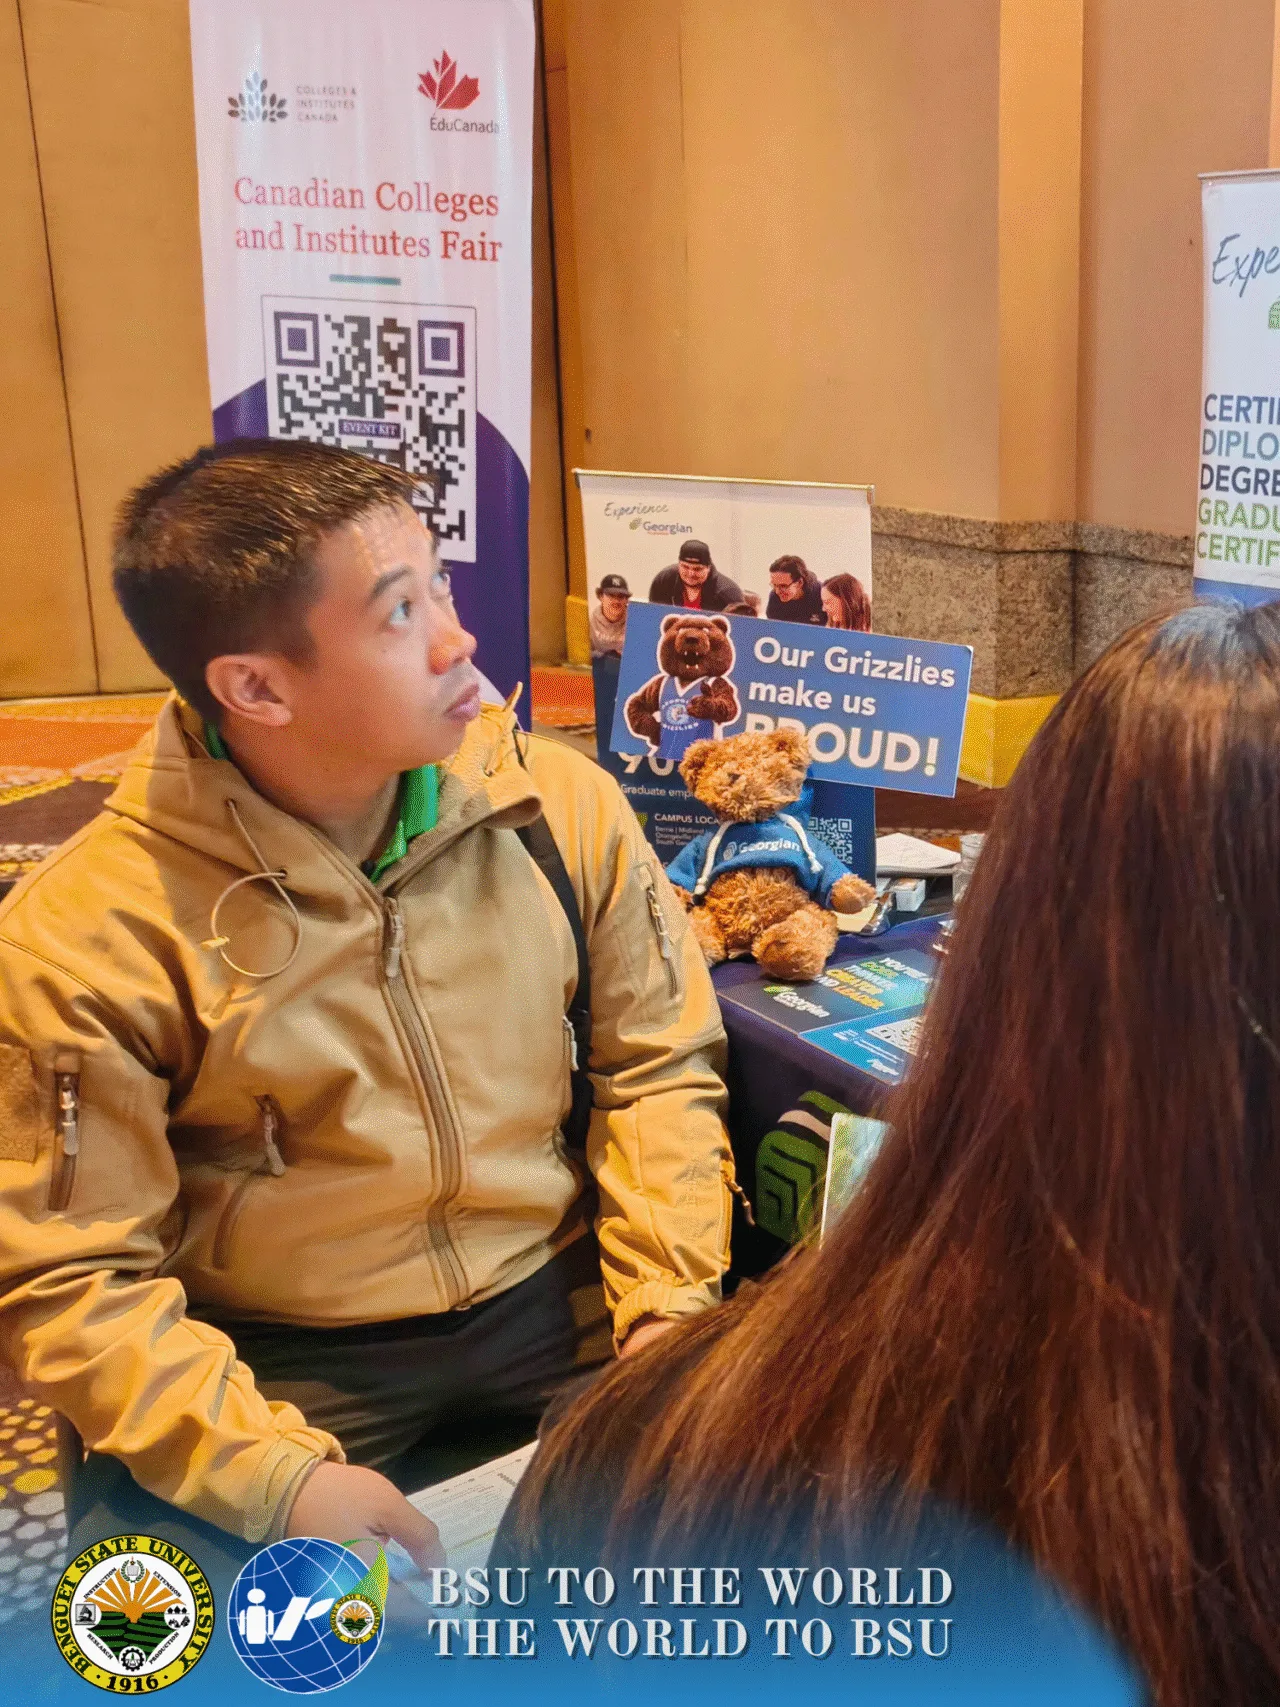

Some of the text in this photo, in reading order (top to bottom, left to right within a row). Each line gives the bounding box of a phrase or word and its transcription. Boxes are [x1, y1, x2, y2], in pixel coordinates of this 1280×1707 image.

[234, 176, 500, 222] Canadian Colleges
[235, 221, 503, 262] and Institutes Fair
[342, 420, 376, 434] EVENT
[604, 501, 669, 520] Experience
[642, 520, 693, 535] Georgian
[753, 636, 956, 688] Our Grizzlies
[748, 679, 877, 716] make us
[620, 784, 667, 797] Graduate
[654, 813, 693, 824] CAMPUS
[738, 838, 800, 853] Georgian
